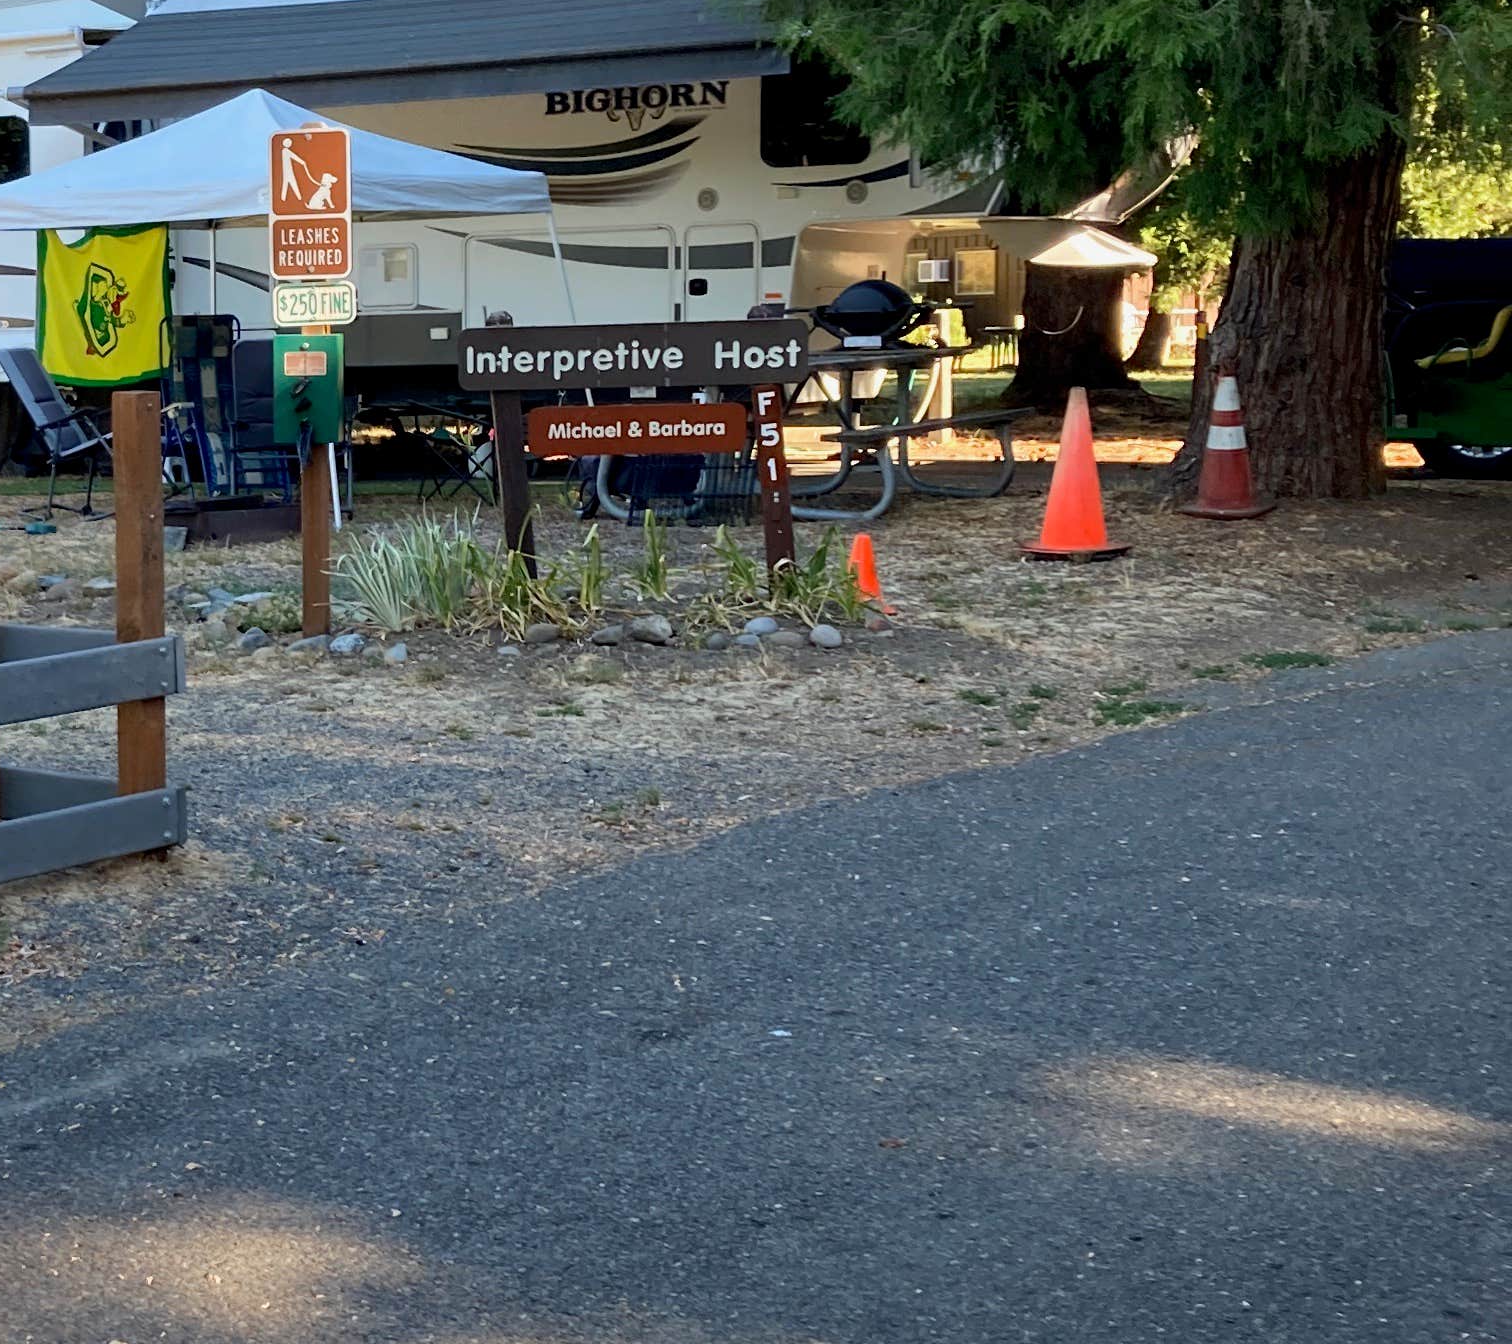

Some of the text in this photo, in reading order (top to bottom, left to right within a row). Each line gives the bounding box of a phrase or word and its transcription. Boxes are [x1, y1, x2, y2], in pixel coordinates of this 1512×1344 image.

[545, 80, 729, 115] BIGHORN
[281, 227, 340, 245] LEASHES
[278, 249, 343, 266] REQUIRED
[279, 291, 350, 316] $250 FINE
[466, 338, 801, 380] Interpretive Host
[548, 419, 726, 440] Michael & Barbara
